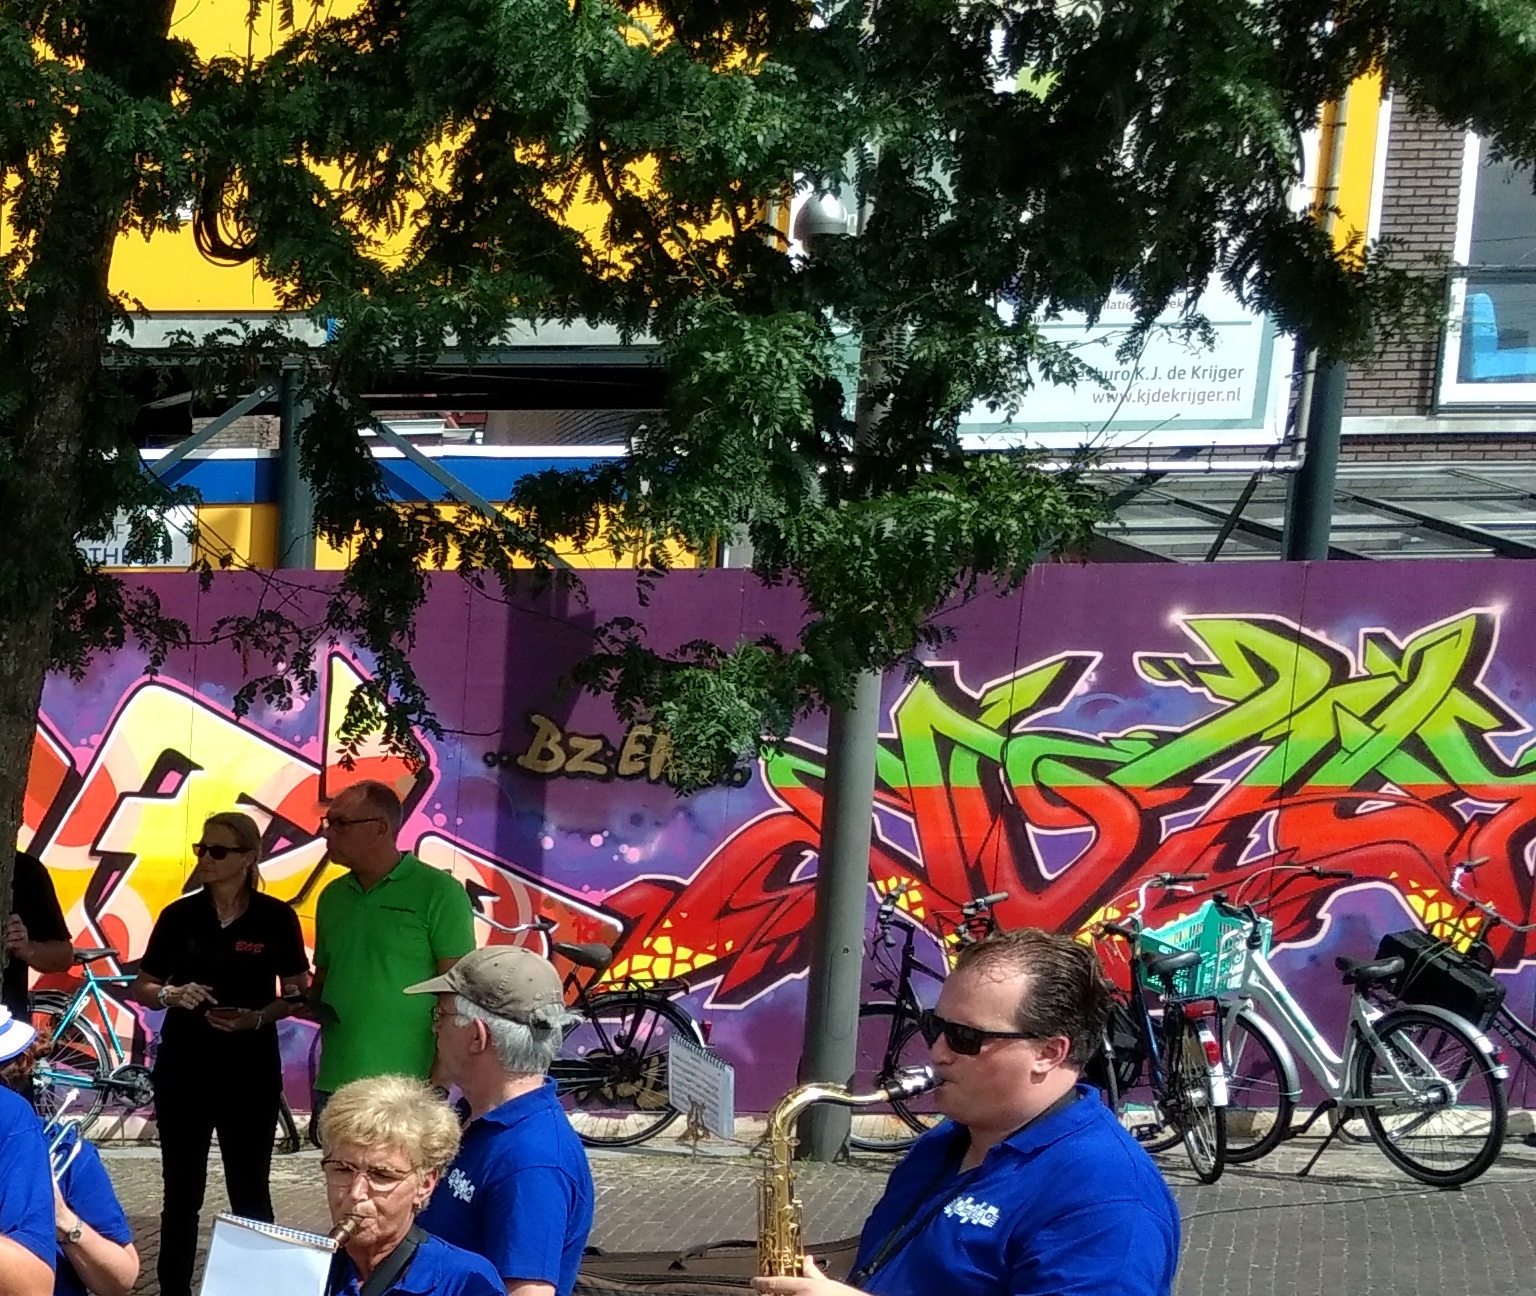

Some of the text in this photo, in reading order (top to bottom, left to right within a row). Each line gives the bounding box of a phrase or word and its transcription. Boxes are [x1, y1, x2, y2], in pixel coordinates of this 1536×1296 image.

[1168, 365, 1186, 380] de
[1191, 365, 1244, 383] Krijger
[1092, 387, 1241, 406] www.kjdekrijger.nl
